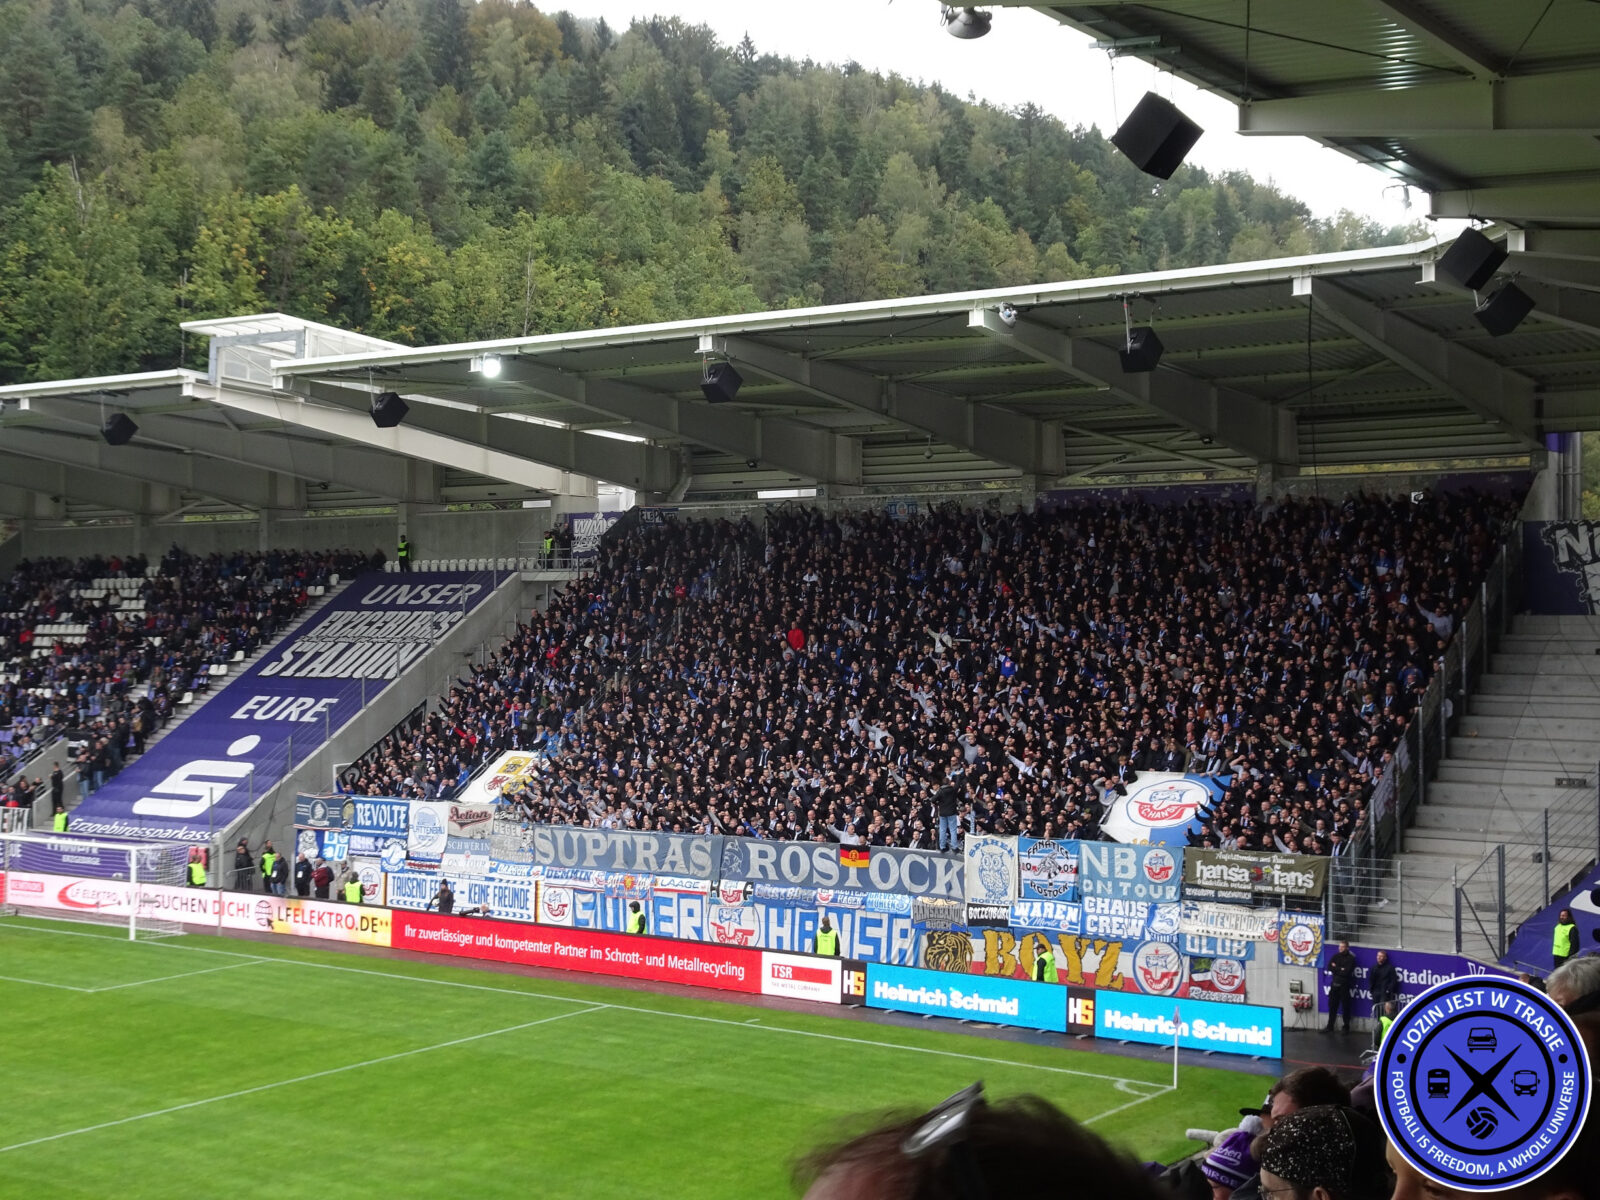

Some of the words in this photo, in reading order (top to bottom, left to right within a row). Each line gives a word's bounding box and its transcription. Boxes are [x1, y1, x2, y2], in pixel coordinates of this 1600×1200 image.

[361, 584, 482, 605] UNSER
[309, 611, 464, 639] ERZGEBIRGS
[258, 641, 430, 679] STADION
[231, 695, 339, 722] EURE
[356, 803, 407, 828] REVOLTE
[449, 805, 492, 821] Action
[447, 841, 490, 851] SCHWERIN
[534, 828, 712, 878] SUPTRAS
[1027, 840, 1071, 860] FANATICS
[546, 867, 591, 881] DEMMIN
[1080, 843, 1137, 880] NB
[661, 879, 700, 890] LAAGE
[1196, 860, 1250, 884] hansa
[1272, 864, 1314, 889] fans
[392, 876, 427, 900] TAUSEND
[430, 879, 457, 903] FEDE
[468, 883, 490, 905] KEINE
[493, 886, 530, 911] FREUNDE
[971, 896, 1015, 905] ROSTOCK
[1030, 881, 1068, 898] ROSTOCK
[1083, 881, 1113, 896] ON
[1119, 883, 1176, 900] TOUR
[155, 894, 207, 914] SUCHEN
[212, 900, 250, 919] DICH!
[573, 890, 705, 943] SUER
[1014, 902, 1079, 923] WAREN
[1083, 896, 1148, 918] CHAOS
[1086, 914, 1145, 938] CREW
[1279, 913, 1325, 926] ALTMARK
[405, 924, 417, 938] Ihr
[418, 928, 474, 947] zuverlässiger
[476, 934, 493, 947] und
[495, 934, 553, 954] kompetenter
[554, 942, 587, 959] Partner
[590, 946, 602, 960] im
[605, 949, 643, 965] Schrott-
[646, 953, 665, 967] und
[667, 957, 745, 981] Metallrecycling
[982, 929, 1125, 991] BOYZ
[1283, 956, 1317, 967] OST
[772, 964, 793, 979] TSR
[843, 969, 865, 997] HS
[874, 980, 947, 1007] Heinrich
[949, 989, 1019, 1016] Schmid
[1068, 997, 1094, 1026] HS
[1104, 1009, 1189, 1037] Heinrich
[1192, 1019, 1272, 1047] Schmid
